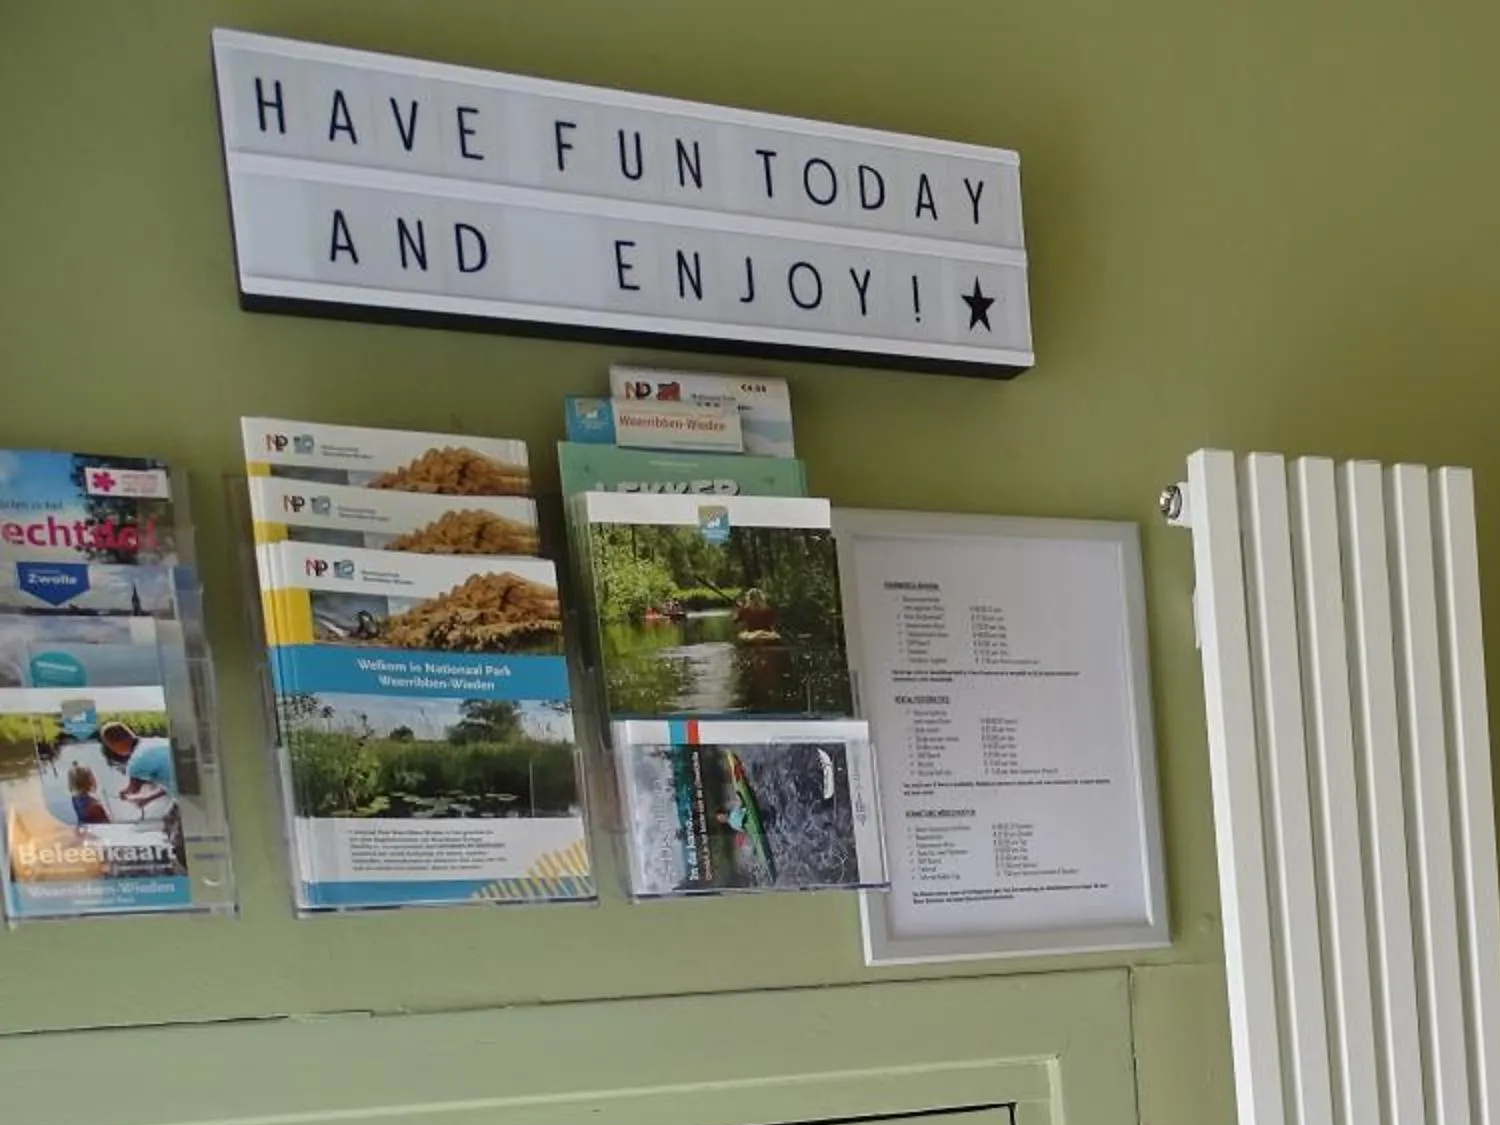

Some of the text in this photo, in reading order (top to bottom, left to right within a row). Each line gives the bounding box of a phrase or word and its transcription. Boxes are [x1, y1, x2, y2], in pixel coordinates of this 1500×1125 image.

[254, 77, 985, 225] HAVE FUN TODAY
[328, 209, 922, 323] AND ENJOY!
[28, 573, 77, 585] Zwolle
[357, 659, 511, 677] Welkom in Nationaal Park
[19, 836, 176, 865] Beleefkaart
